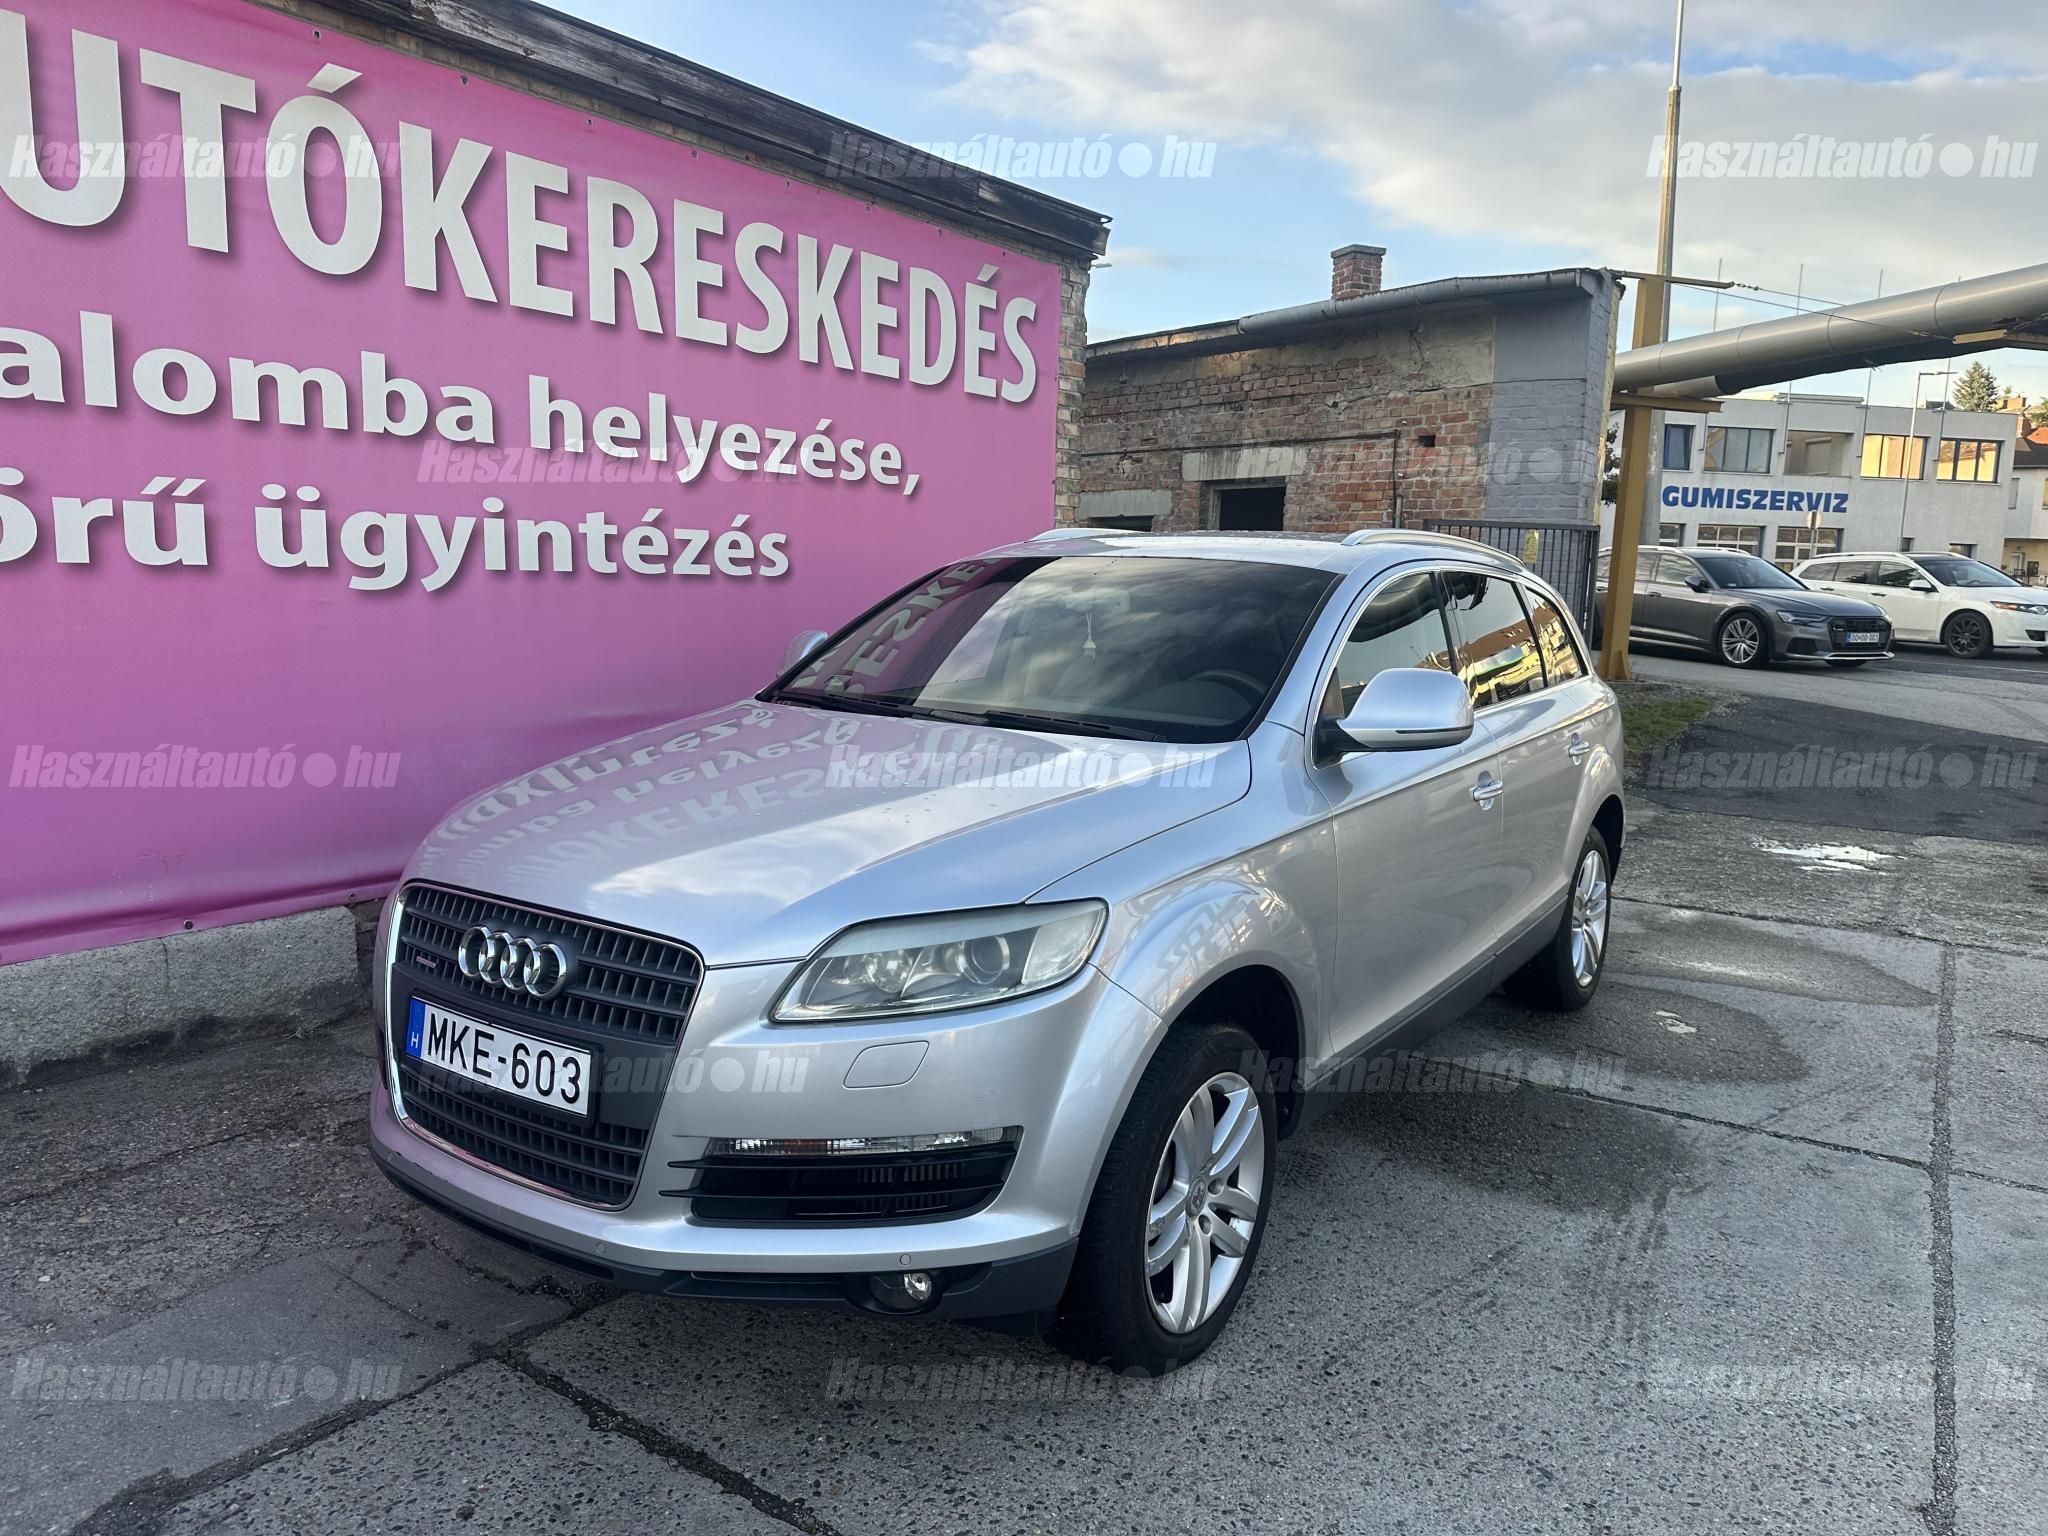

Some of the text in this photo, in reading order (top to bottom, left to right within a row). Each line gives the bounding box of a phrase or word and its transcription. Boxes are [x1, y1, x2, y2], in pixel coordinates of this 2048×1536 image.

[0, 8, 1037, 402] UTÓKERESKEDÉS
[529, 374, 920, 496] helyezése,
[254, 483, 789, 592] ügyintézés
[1662, 485, 1849, 513] GUMISZERVIZ
[427, 1013, 581, 1104] MKE-603
